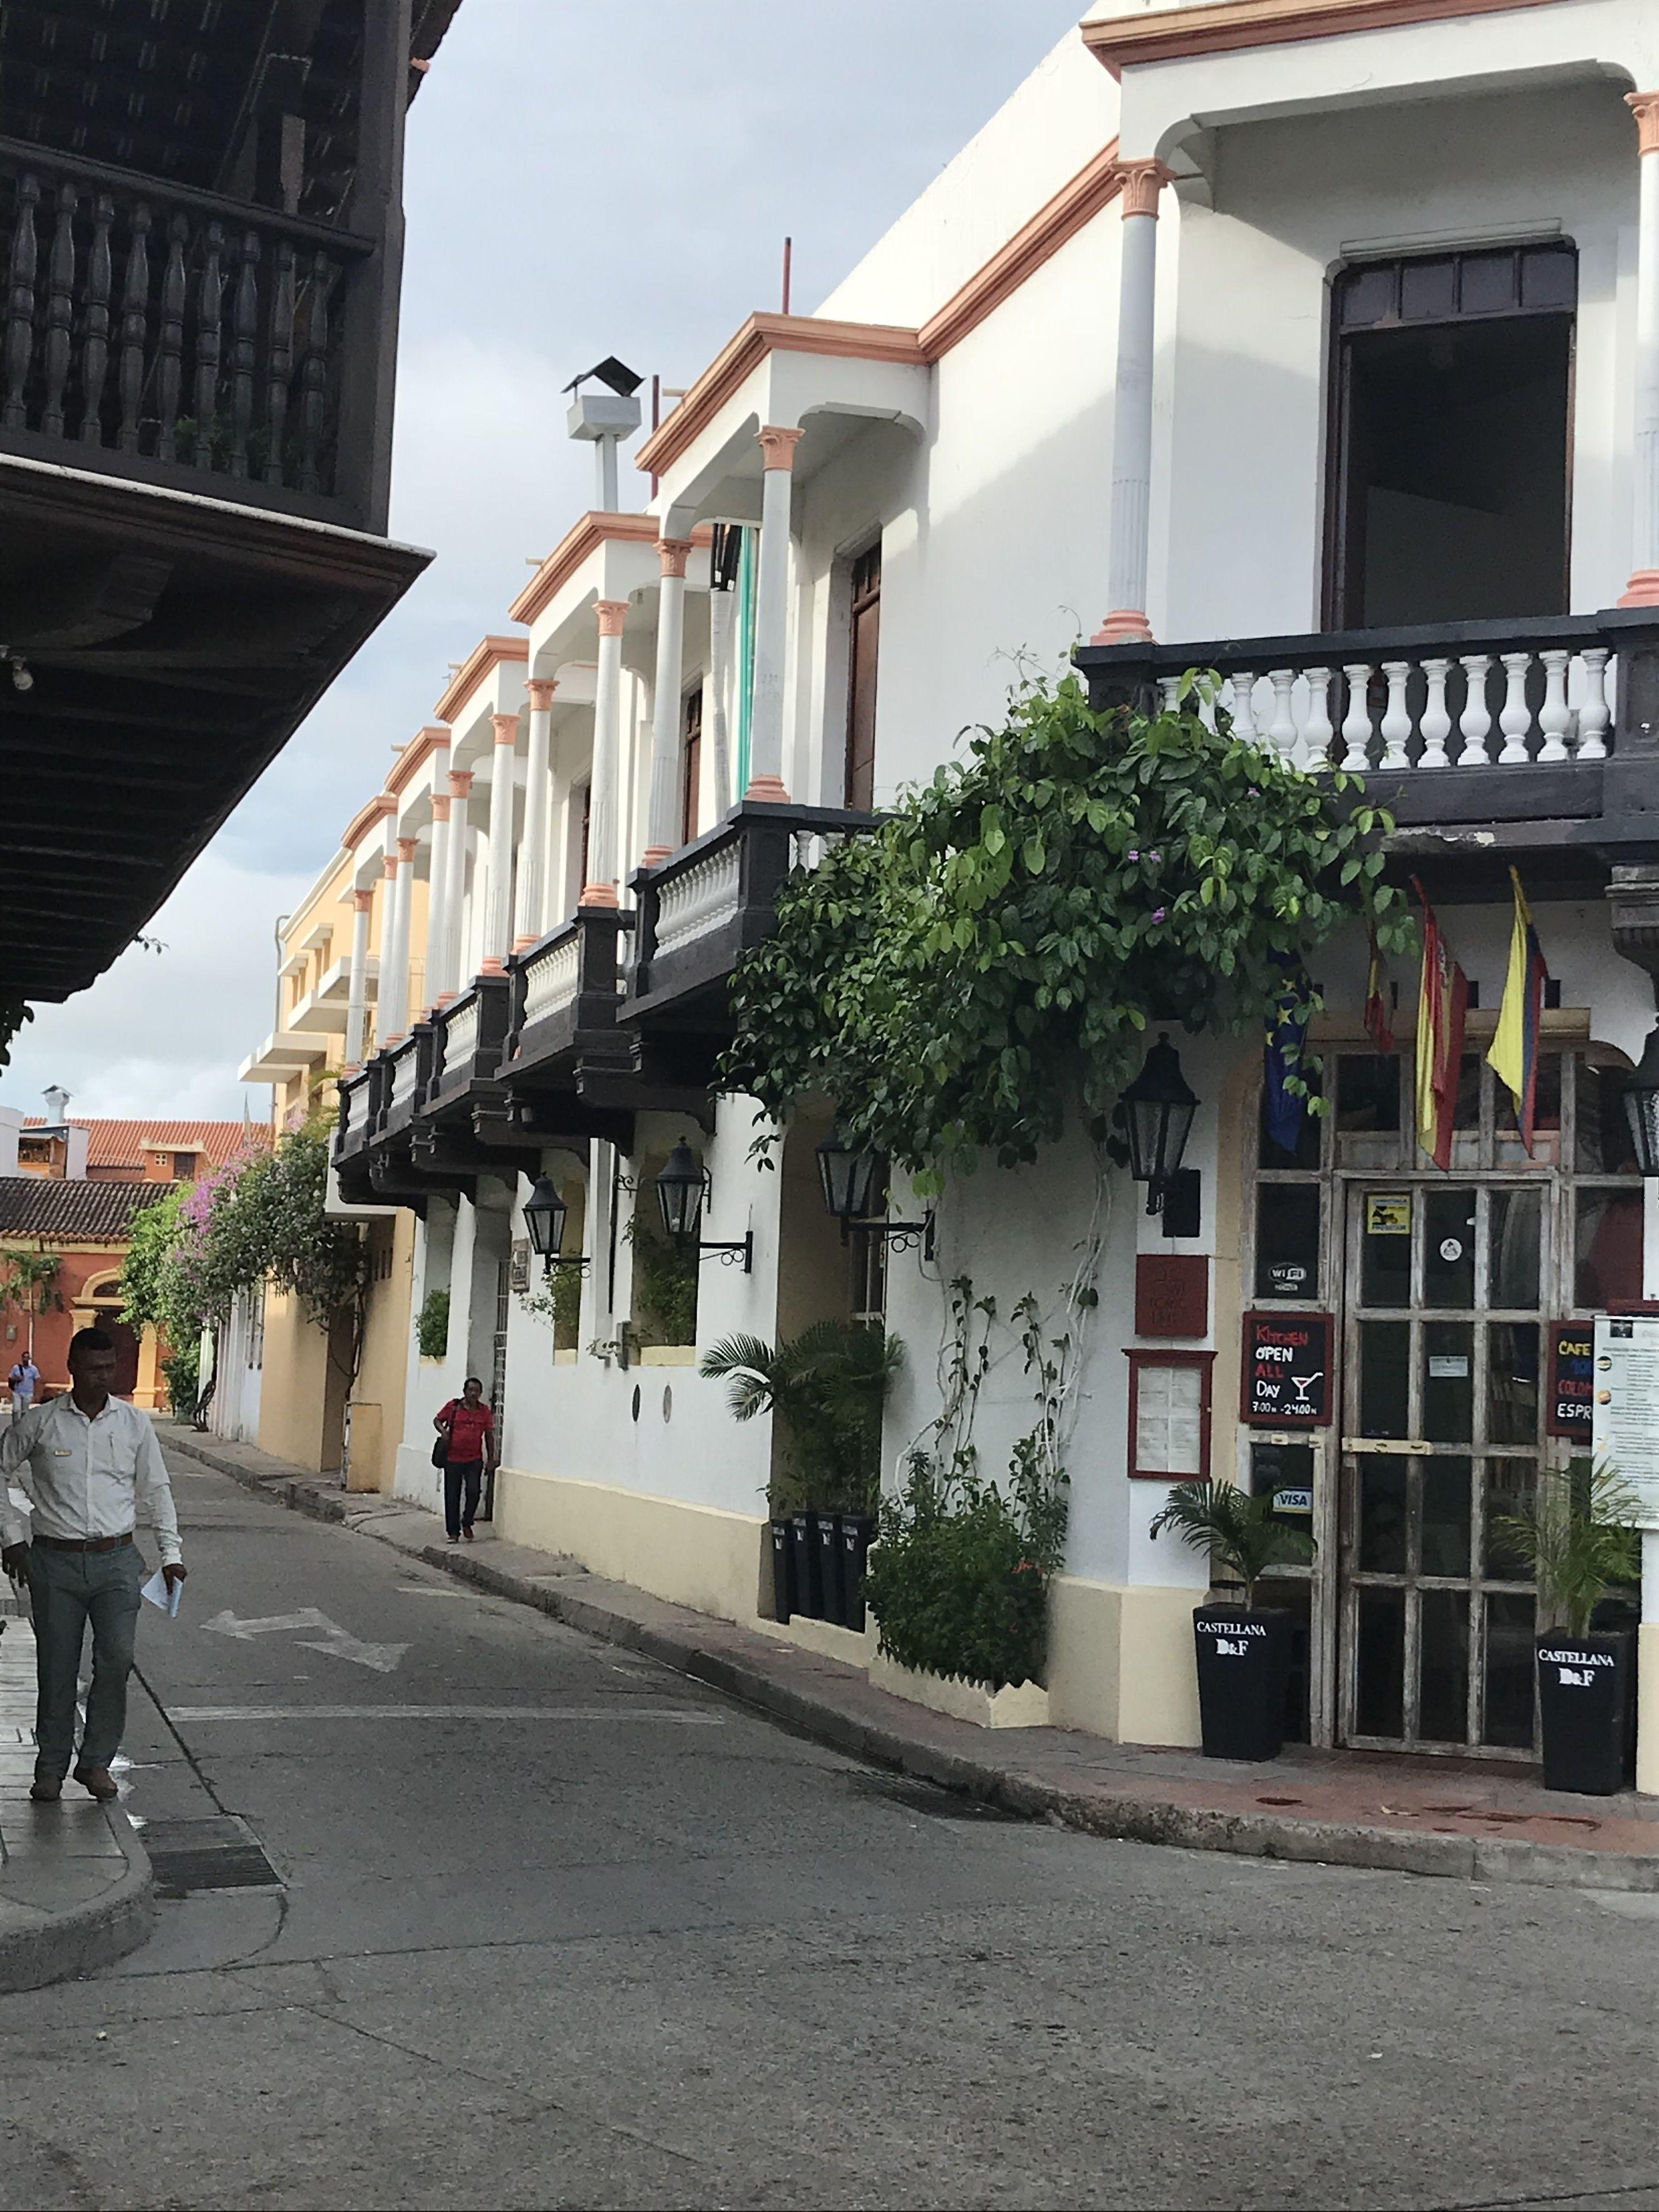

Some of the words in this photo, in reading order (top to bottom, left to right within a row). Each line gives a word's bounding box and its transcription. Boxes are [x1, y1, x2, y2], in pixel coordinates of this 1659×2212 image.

[1255, 1346, 1293, 1362] OPEN
[1255, 1363, 1284, 1378] ALL
[1256, 1380, 1281, 1398] DAY
[1279, 1494, 1307, 1506] VISA
[1196, 1621, 1267, 1636] CASTELLANA
[1538, 1649, 1615, 1667] CASTELLANA
